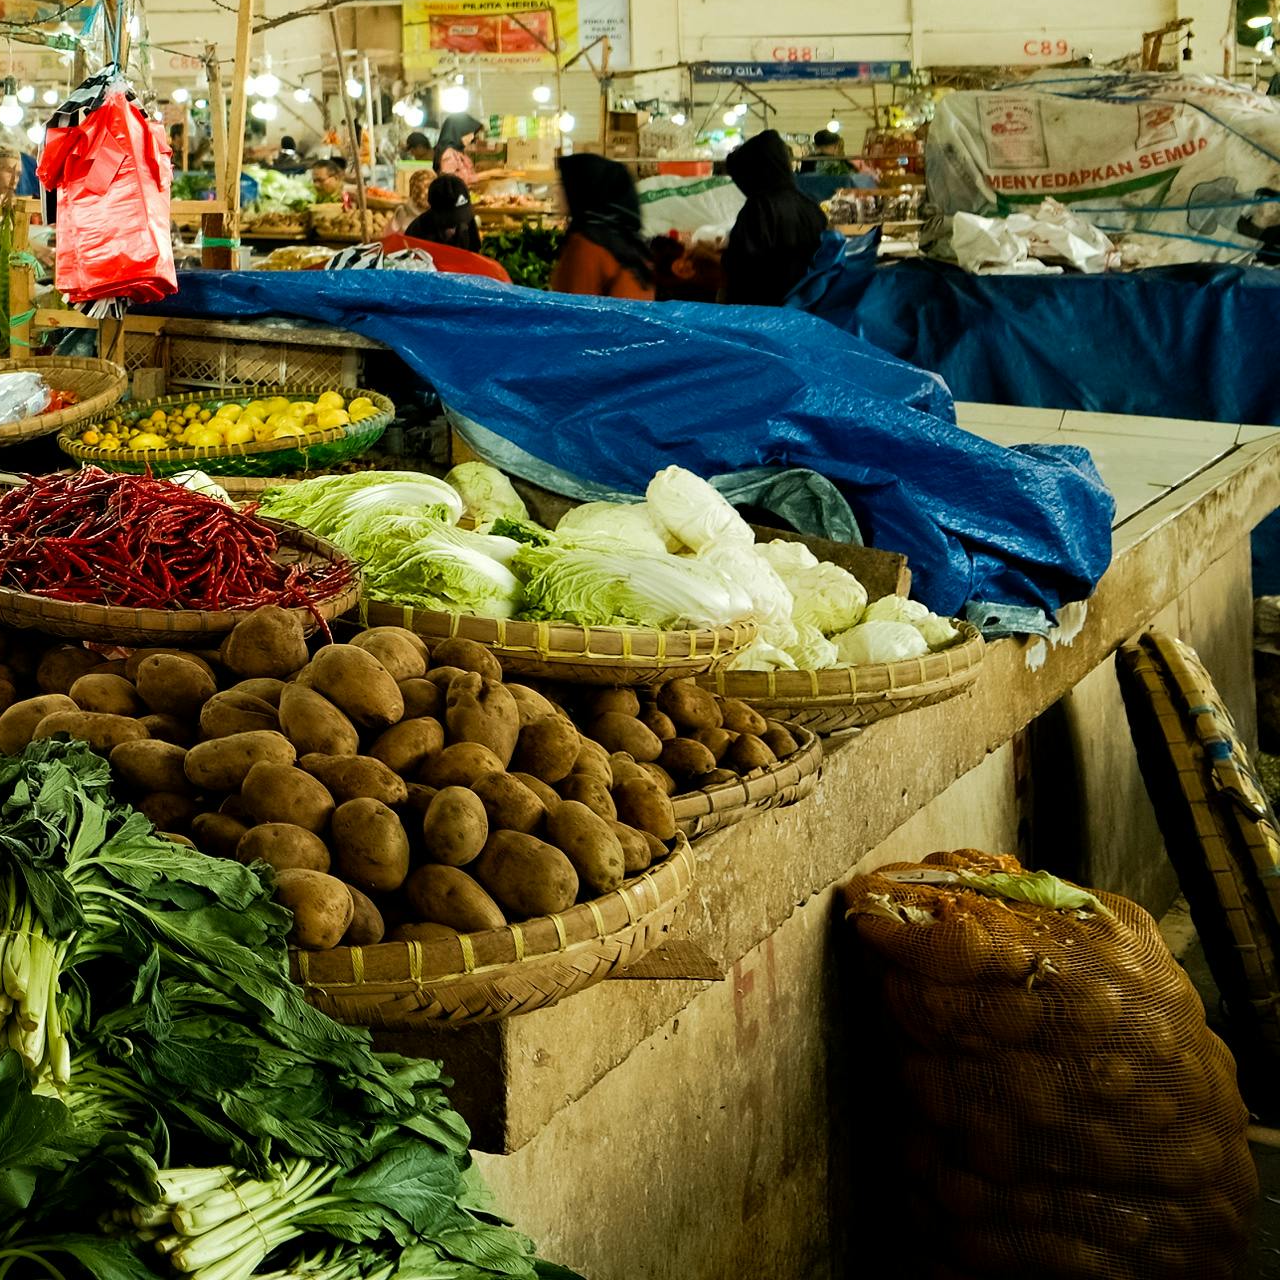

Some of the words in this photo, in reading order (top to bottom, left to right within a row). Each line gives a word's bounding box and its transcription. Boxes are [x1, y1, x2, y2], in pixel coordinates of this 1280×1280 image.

[772, 47, 812, 61] C88
[1023, 39, 1068, 56] C89
[735, 64, 764, 76] QILA
[986, 161, 1134, 190] MENYEDAPKAN
